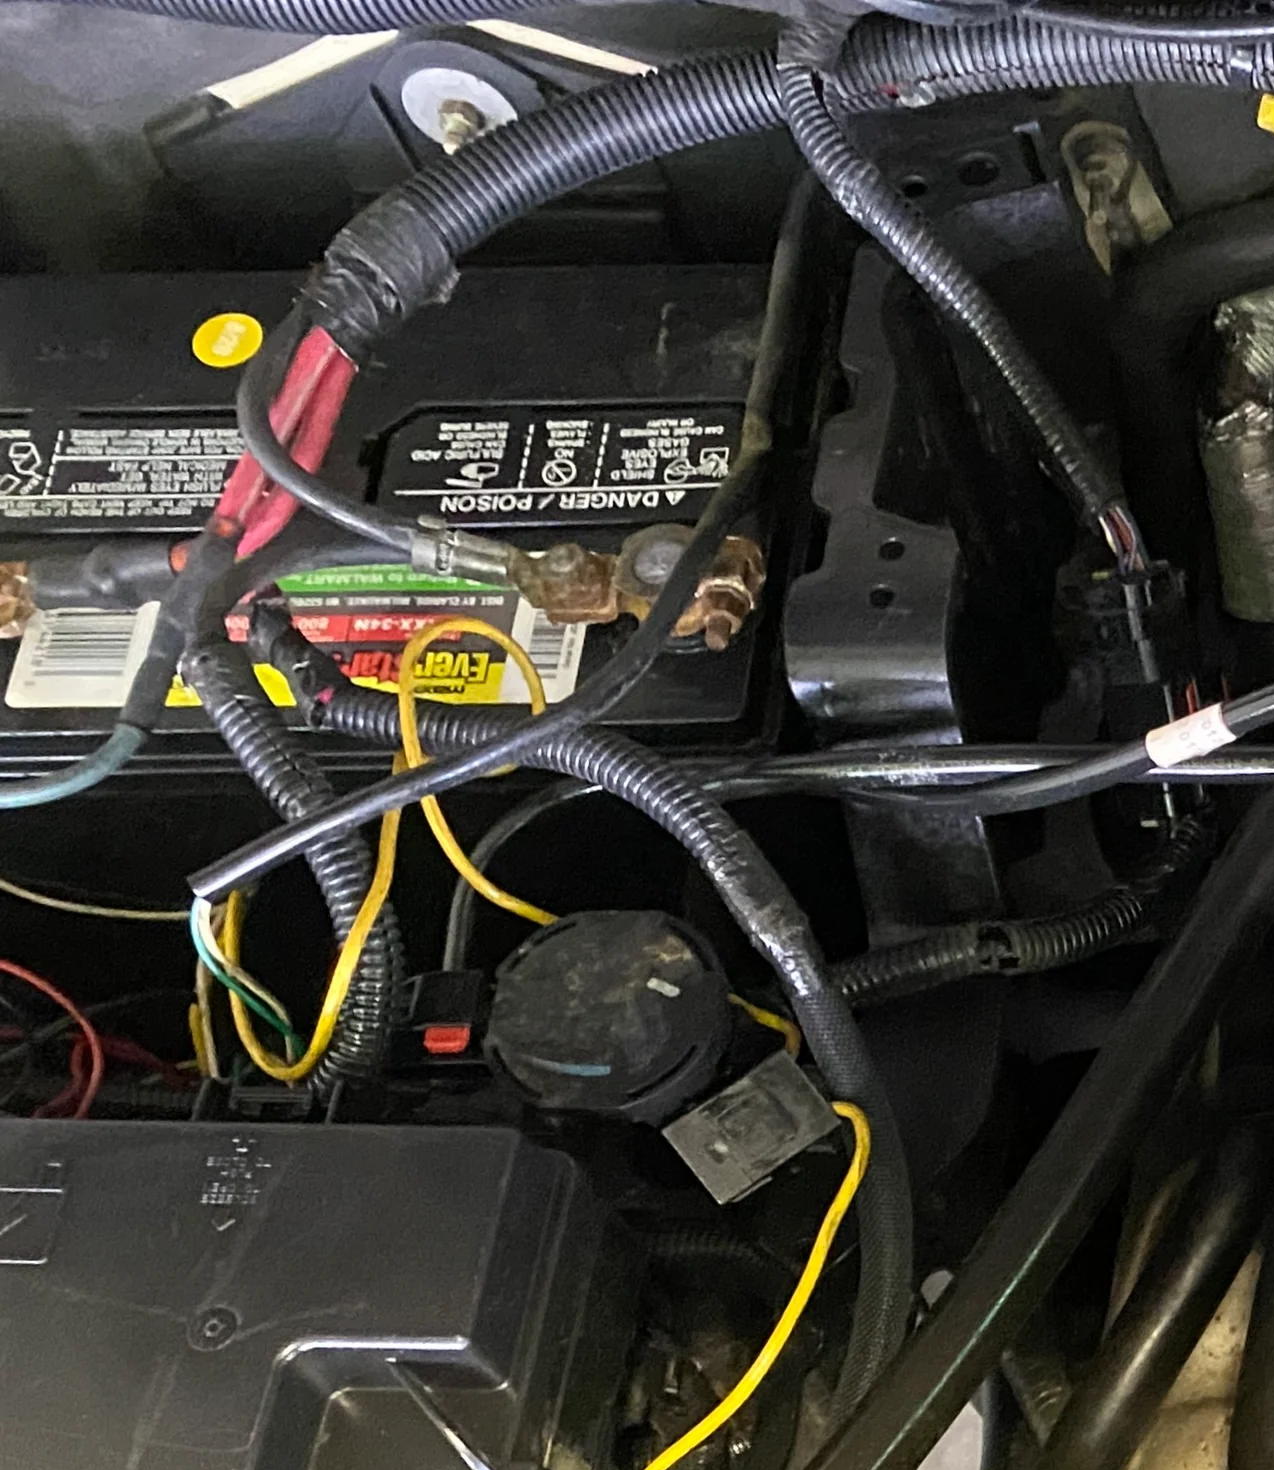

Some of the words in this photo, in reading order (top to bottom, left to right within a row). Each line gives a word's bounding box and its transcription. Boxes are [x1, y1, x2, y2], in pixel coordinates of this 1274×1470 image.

[475, 422, 509, 431] SEVERE
[681, 418, 694, 426] OR
[620, 428, 670, 438] BLINDNESS
[673, 426, 702, 436] CAUSE
[705, 425, 724, 434] CAN
[438, 432, 453, 440] OR
[456, 430, 508, 440] BLINDNESS
[451, 440, 483, 448] CAUSE
[485, 440, 506, 448] CAN
[648, 437, 689, 448] GASES
[411, 449, 442, 461] ACID
[444, 448, 504, 460] SULFURIC
[555, 447, 574, 458] NO
[621, 447, 688, 459] EXPLOSIVE
[108, 461, 139, 471] FAST
[141, 461, 172, 471] HELP
[178, 461, 227, 471] MEDICAL
[625, 458, 656, 469] EYES
[193, 471, 223, 481] WITH
[610, 469, 655, 480] SHIELD
[67, 482, 147, 492] IMMEDIATELY
[150, 482, 180, 492] EYES
[184, 482, 221, 492] FLUSH
[440, 494, 533, 512] POISON
[560, 491, 659, 509] DANGER
[304, 574, 384, 585] WALMART
[388, 573, 403, 584] to
